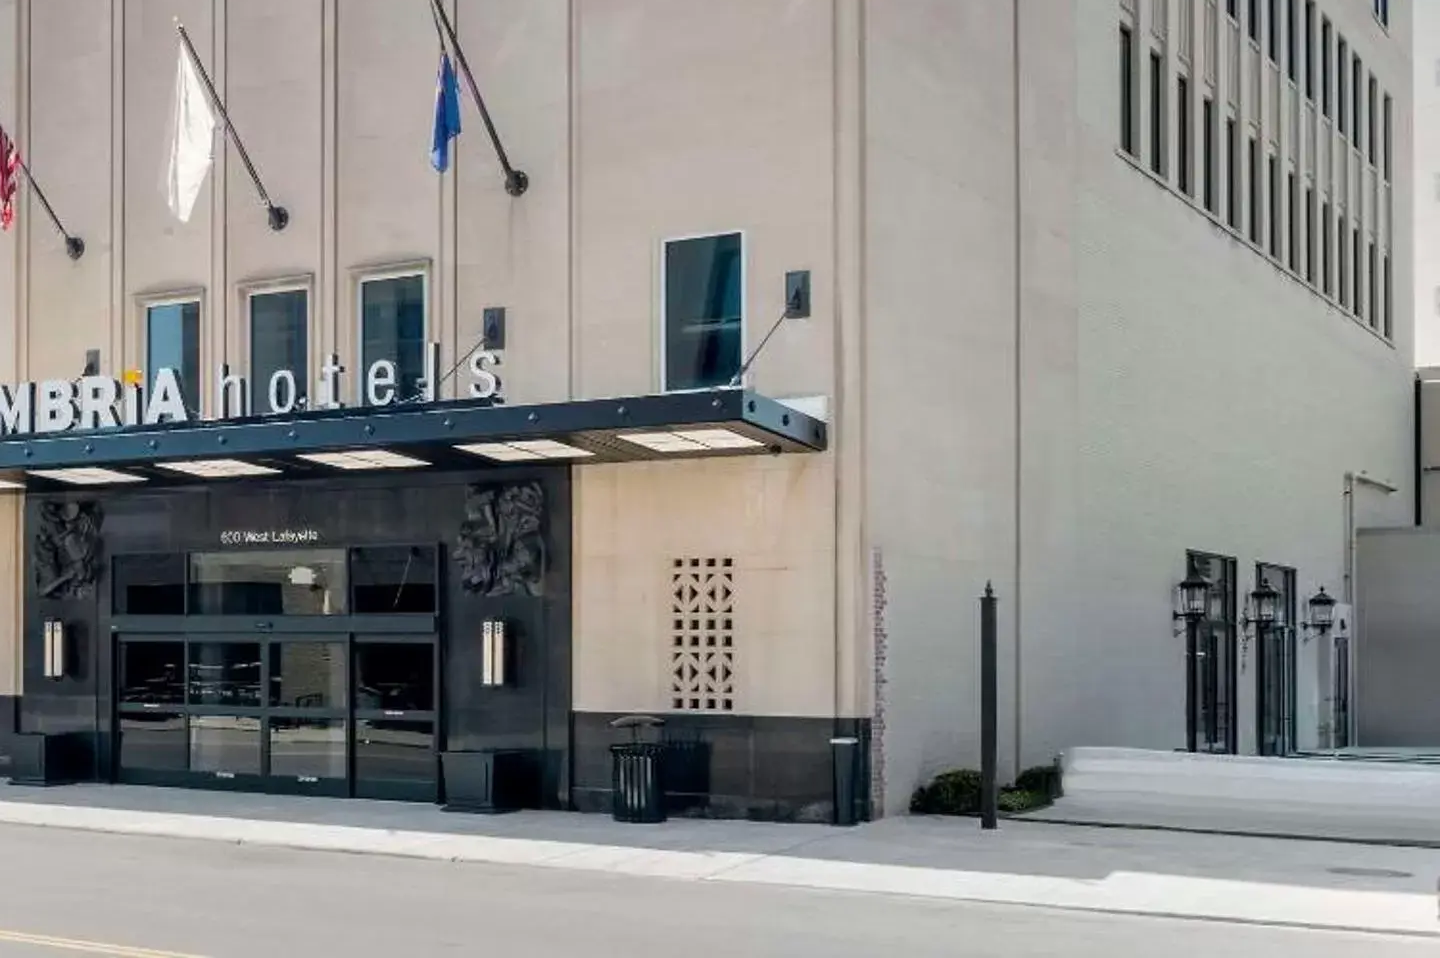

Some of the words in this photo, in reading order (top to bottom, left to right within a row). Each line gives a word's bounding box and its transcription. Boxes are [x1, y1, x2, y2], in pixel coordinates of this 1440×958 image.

[218, 342, 504, 422] hotels
[220, 531, 240, 544] 600
[243, 530, 268, 543] West
